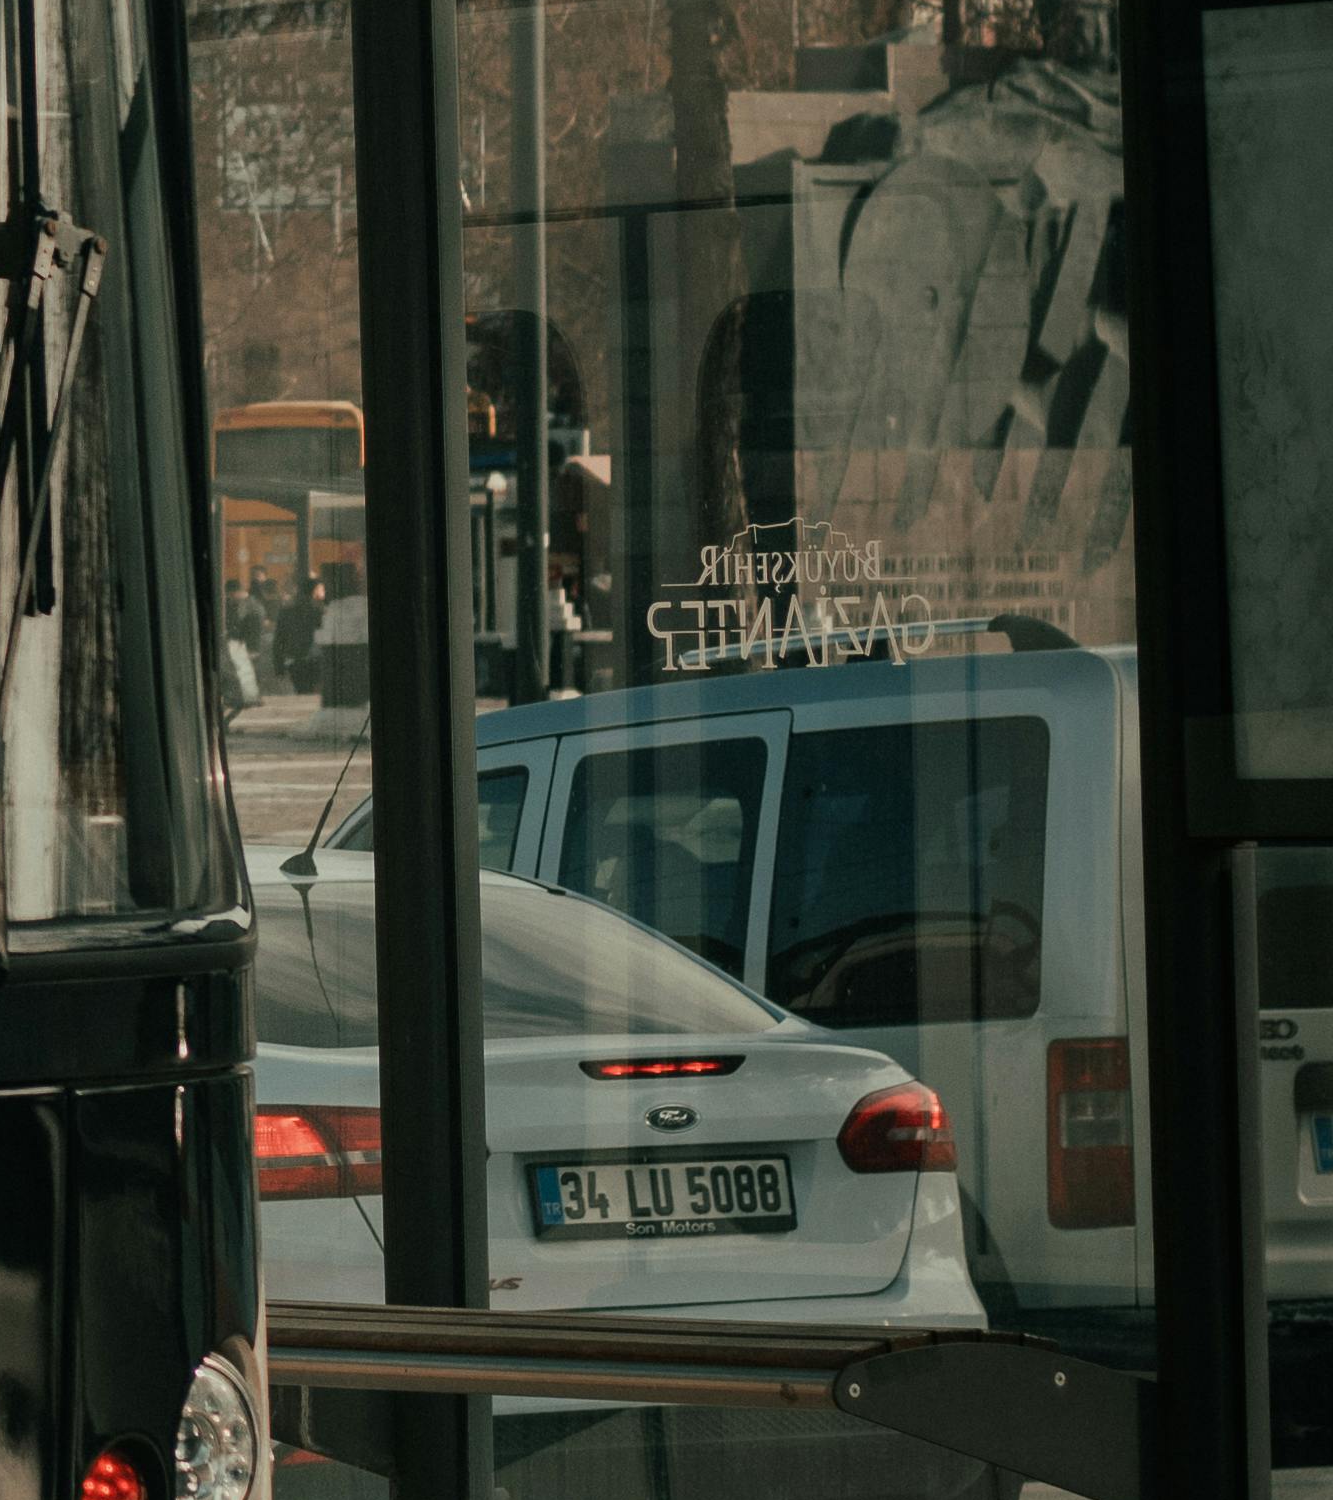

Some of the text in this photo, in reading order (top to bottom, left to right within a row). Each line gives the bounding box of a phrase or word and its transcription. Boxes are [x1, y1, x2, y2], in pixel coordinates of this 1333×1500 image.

[560, 1171, 610, 1219] 34
[625, 1167, 675, 1217] LU
[686, 1164, 782, 1215] 5088
[625, 1218, 717, 1235] Son Motors
